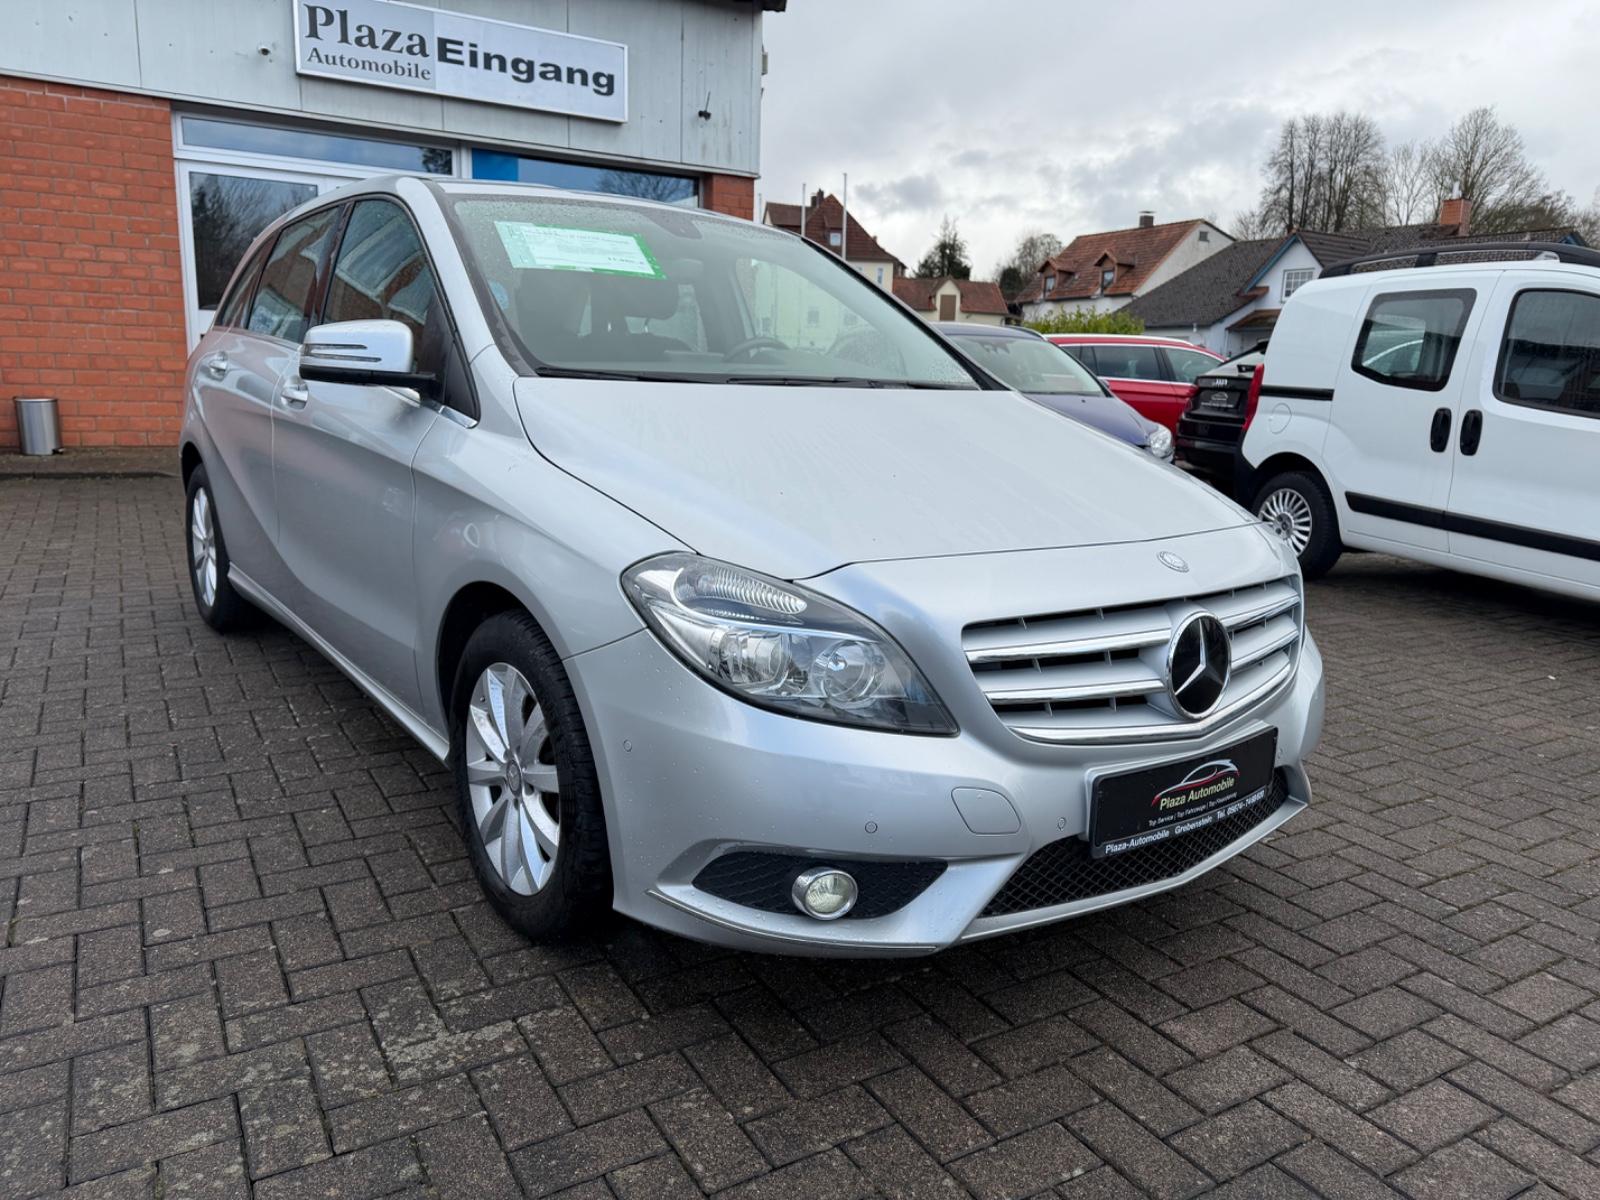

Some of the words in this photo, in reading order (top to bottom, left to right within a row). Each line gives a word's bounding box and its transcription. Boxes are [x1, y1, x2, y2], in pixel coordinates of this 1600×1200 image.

[304, 4, 430, 58] Plaza
[307, 47, 431, 81] Automobile
[437, 37, 615, 96] Eingang
[1160, 795, 1186, 810] Plaza
[1188, 777, 1235, 801] Automobile
[1105, 829, 1170, 854] Plaza-Automobile
